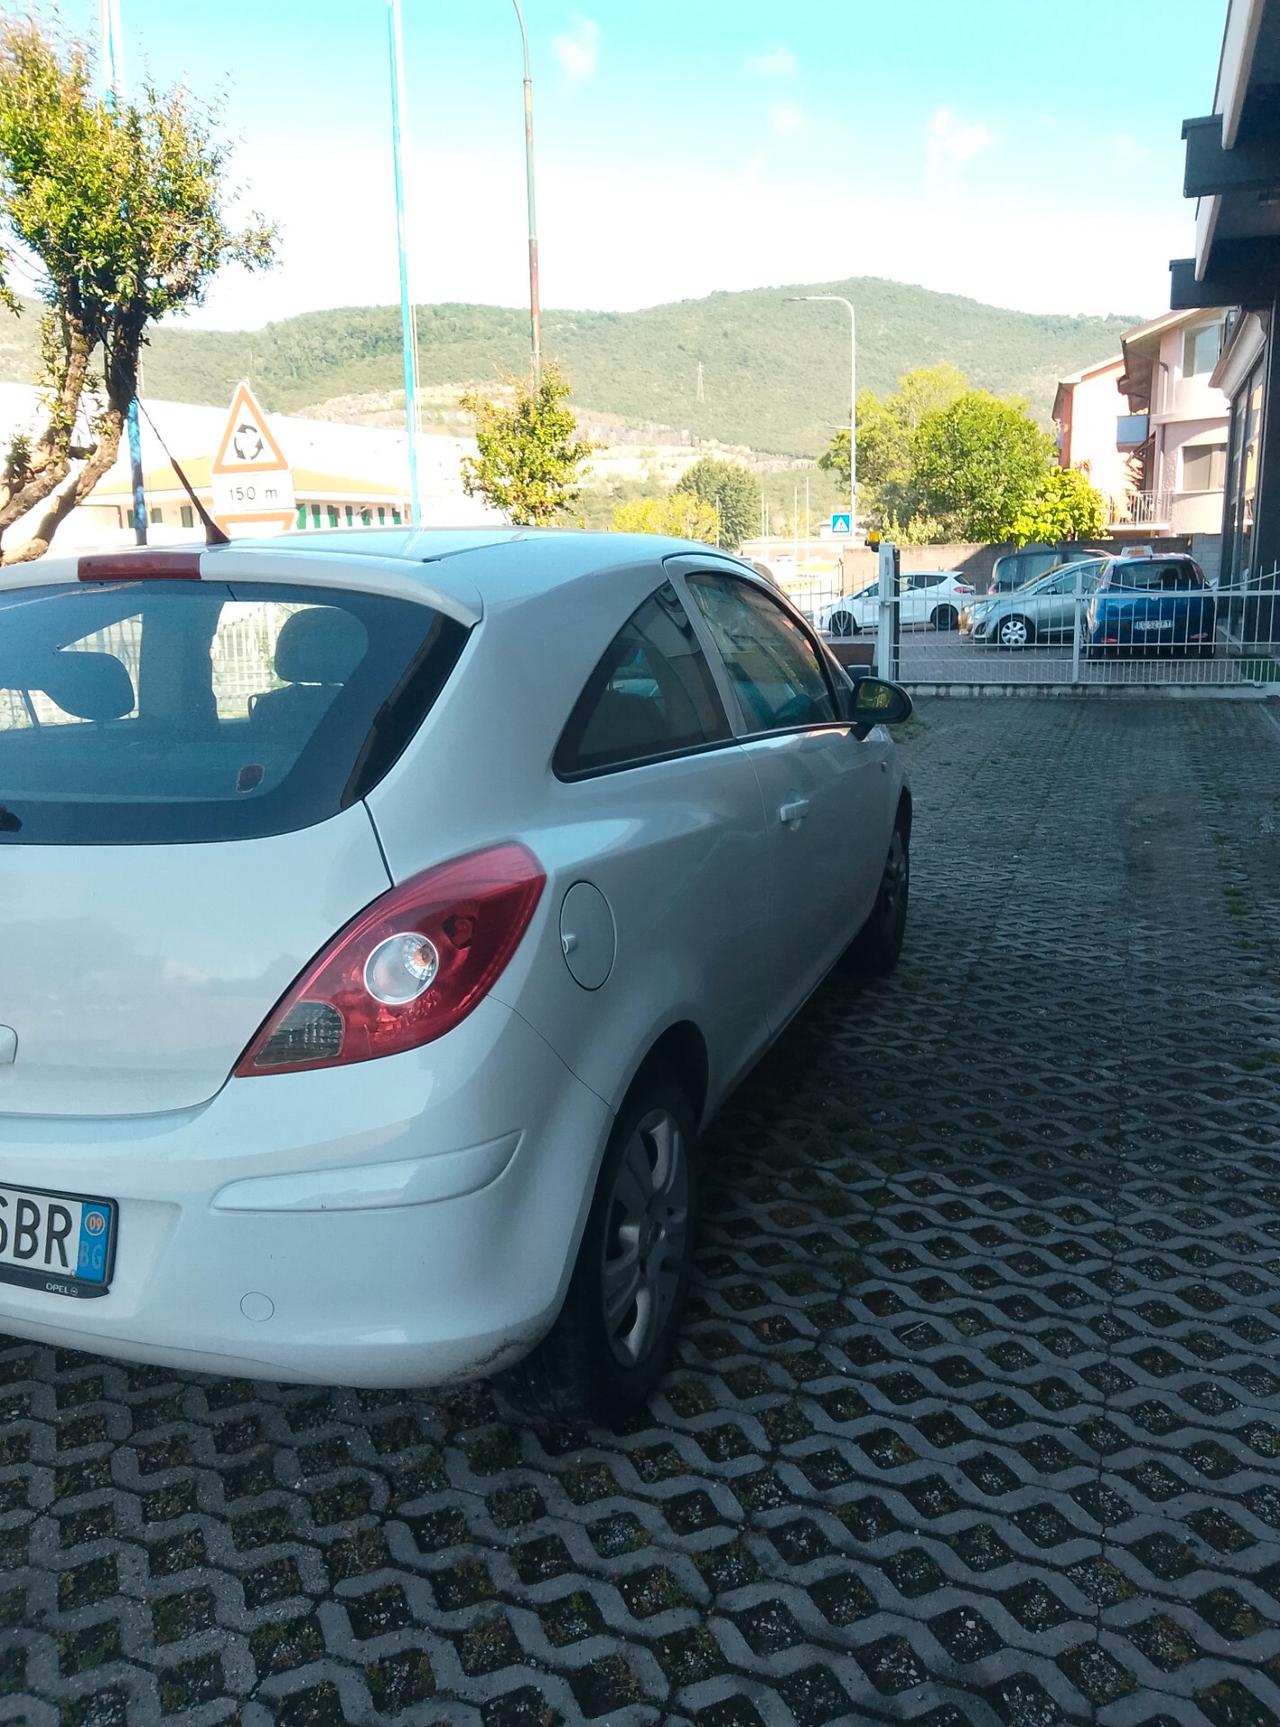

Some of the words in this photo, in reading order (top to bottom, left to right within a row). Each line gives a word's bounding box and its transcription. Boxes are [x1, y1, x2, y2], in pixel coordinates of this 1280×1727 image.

[229, 486, 256, 501] 150
[265, 488, 278, 499] m
[89, 1214, 103, 1232] 09
[79, 1241, 104, 1269] BG
[45, 1282, 71, 1294] OPEL
